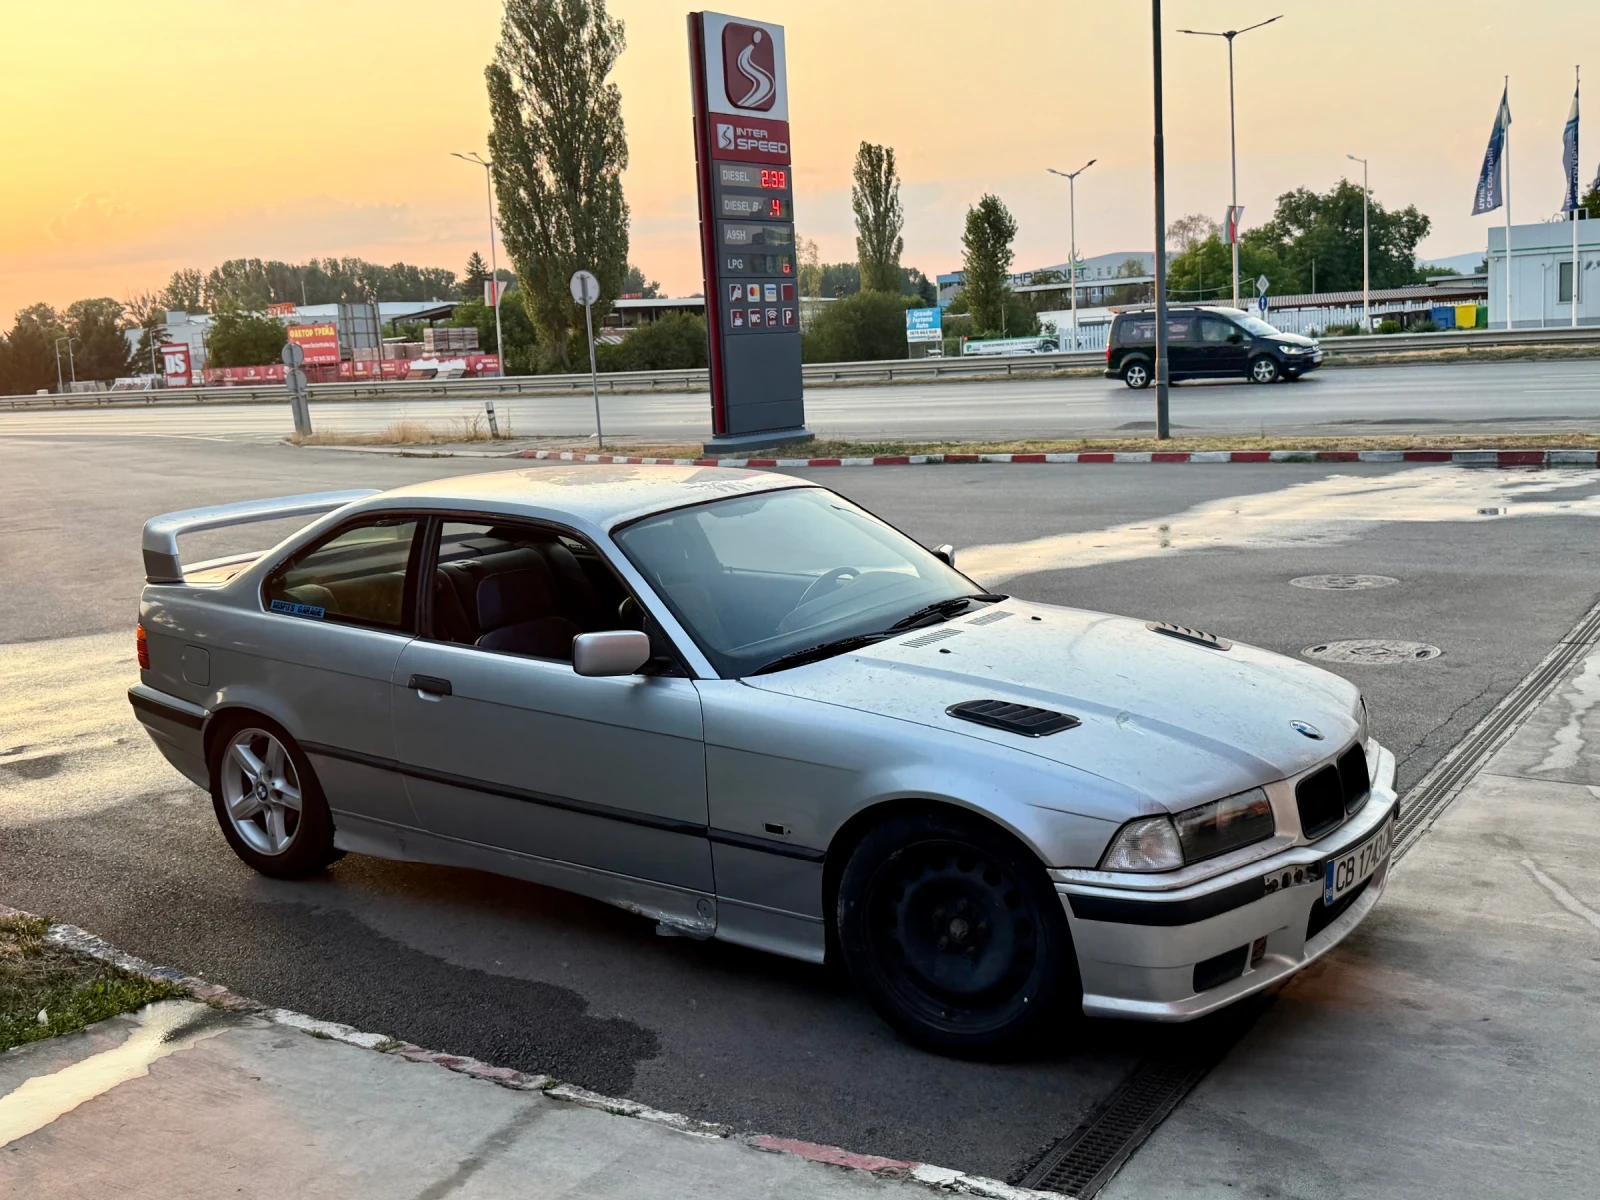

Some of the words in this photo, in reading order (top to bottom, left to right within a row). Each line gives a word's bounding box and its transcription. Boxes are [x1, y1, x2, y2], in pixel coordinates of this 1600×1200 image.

[736, 127, 768, 138] INTER
[736, 138, 788, 154] SPEED
[722, 170, 750, 182] DIESEL
[724, 200, 751, 212] DIESEL
[727, 258, 744, 269] LPG
[750, 313, 761, 323] WC
[785, 310, 792, 325] P
[289, 329, 314, 338] ФАКТОР
[314, 325, 335, 337] ТРЕЙД
[164, 353, 187, 375] DS
[1336, 856, 1355, 892] CB
